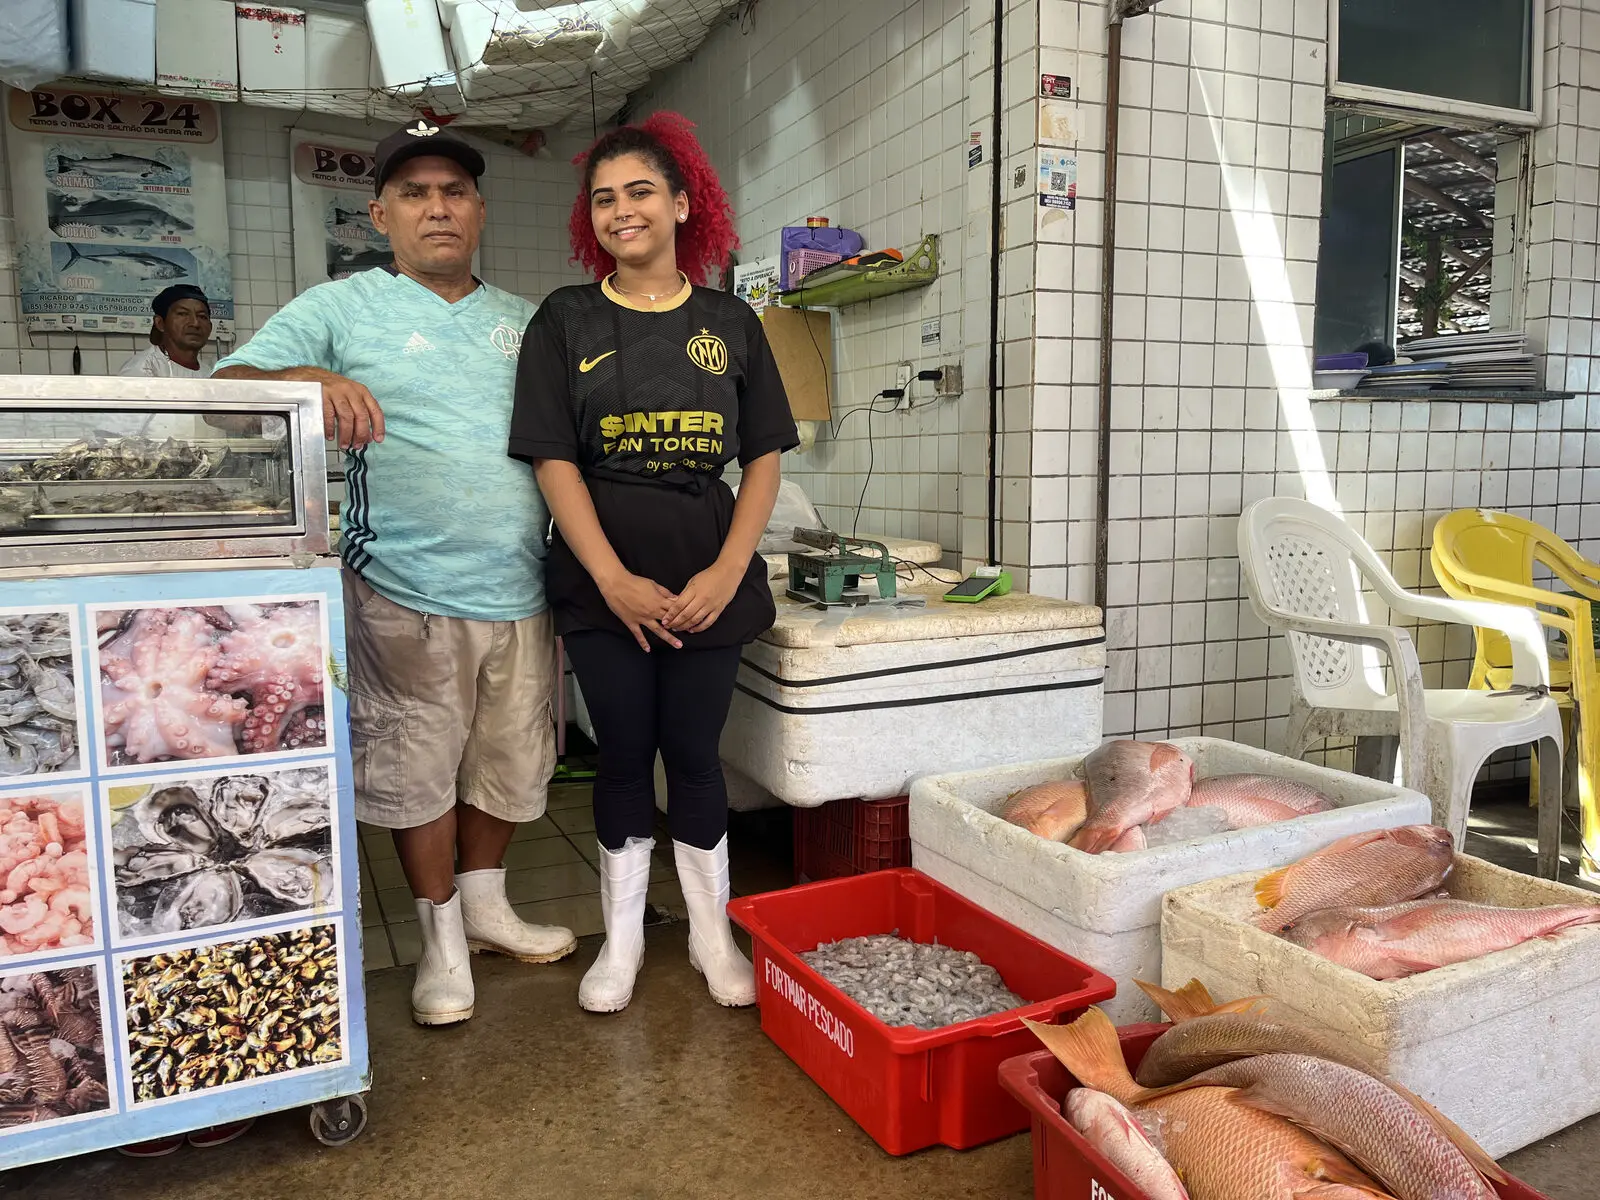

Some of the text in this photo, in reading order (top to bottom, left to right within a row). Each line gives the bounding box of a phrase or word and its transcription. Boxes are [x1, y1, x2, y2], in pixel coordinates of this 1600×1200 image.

[29, 91, 200, 129] BOX 24
[29, 118, 58, 126] TEMOS
[69, 122, 105, 130] MELHOR
[183, 129, 203, 137] MAR
[312, 173, 338, 182] TEMOS
[346, 178, 376, 186] MELHO
[39, 294, 75, 302] RICARDO
[600, 411, 724, 440] $INTER
[603, 436, 723, 456] FAN TOKEN
[765, 957, 854, 1058] FORTMAR PESCADO
